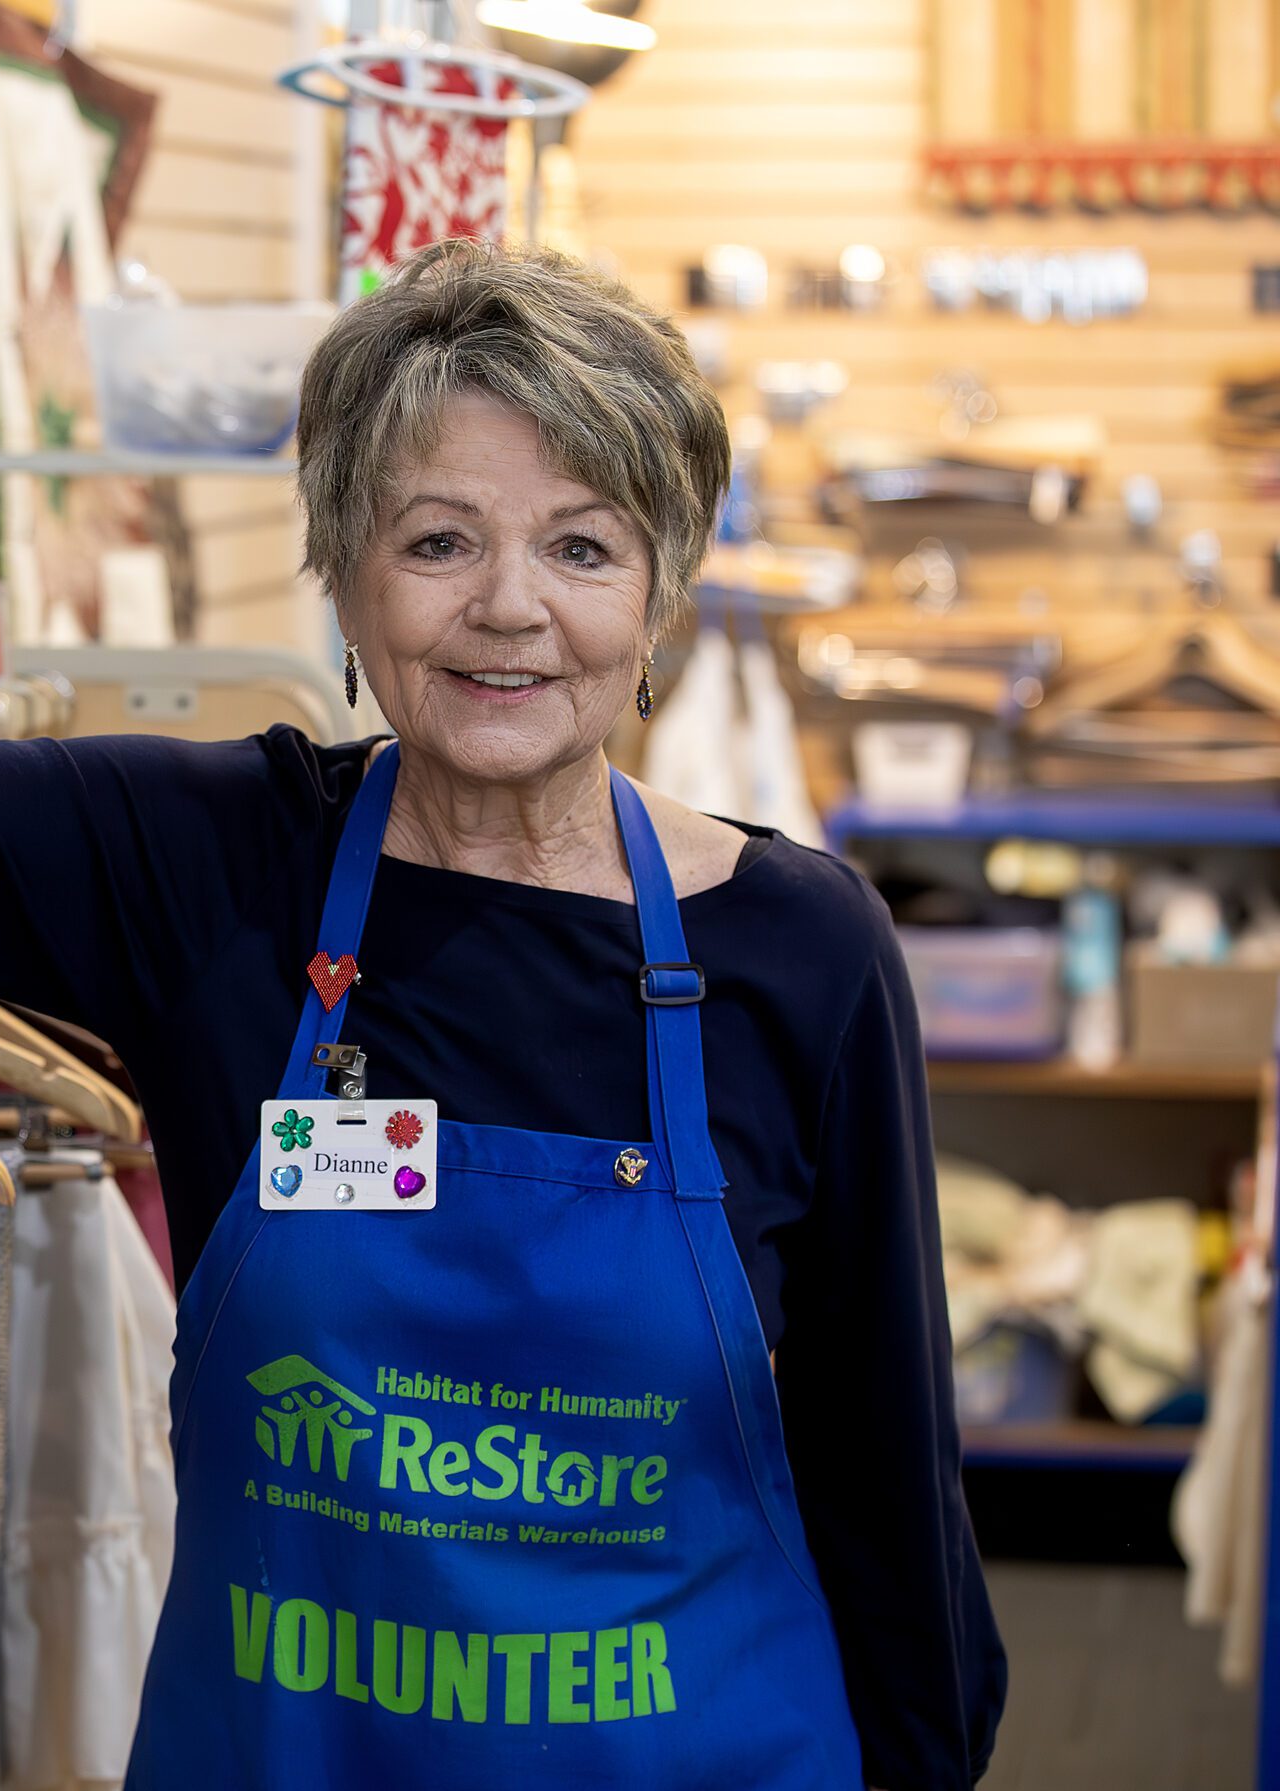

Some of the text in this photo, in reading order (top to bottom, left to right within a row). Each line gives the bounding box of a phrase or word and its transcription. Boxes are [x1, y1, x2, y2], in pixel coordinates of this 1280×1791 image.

[313, 1153, 389, 1175] Dianne
[376, 1366, 681, 1426] Habitat for Humanity
[379, 1413, 668, 1507] ReStore
[244, 1479, 667, 1545] A Building Materials Warehouse
[229, 1582, 677, 1726] VOLUNTEER
